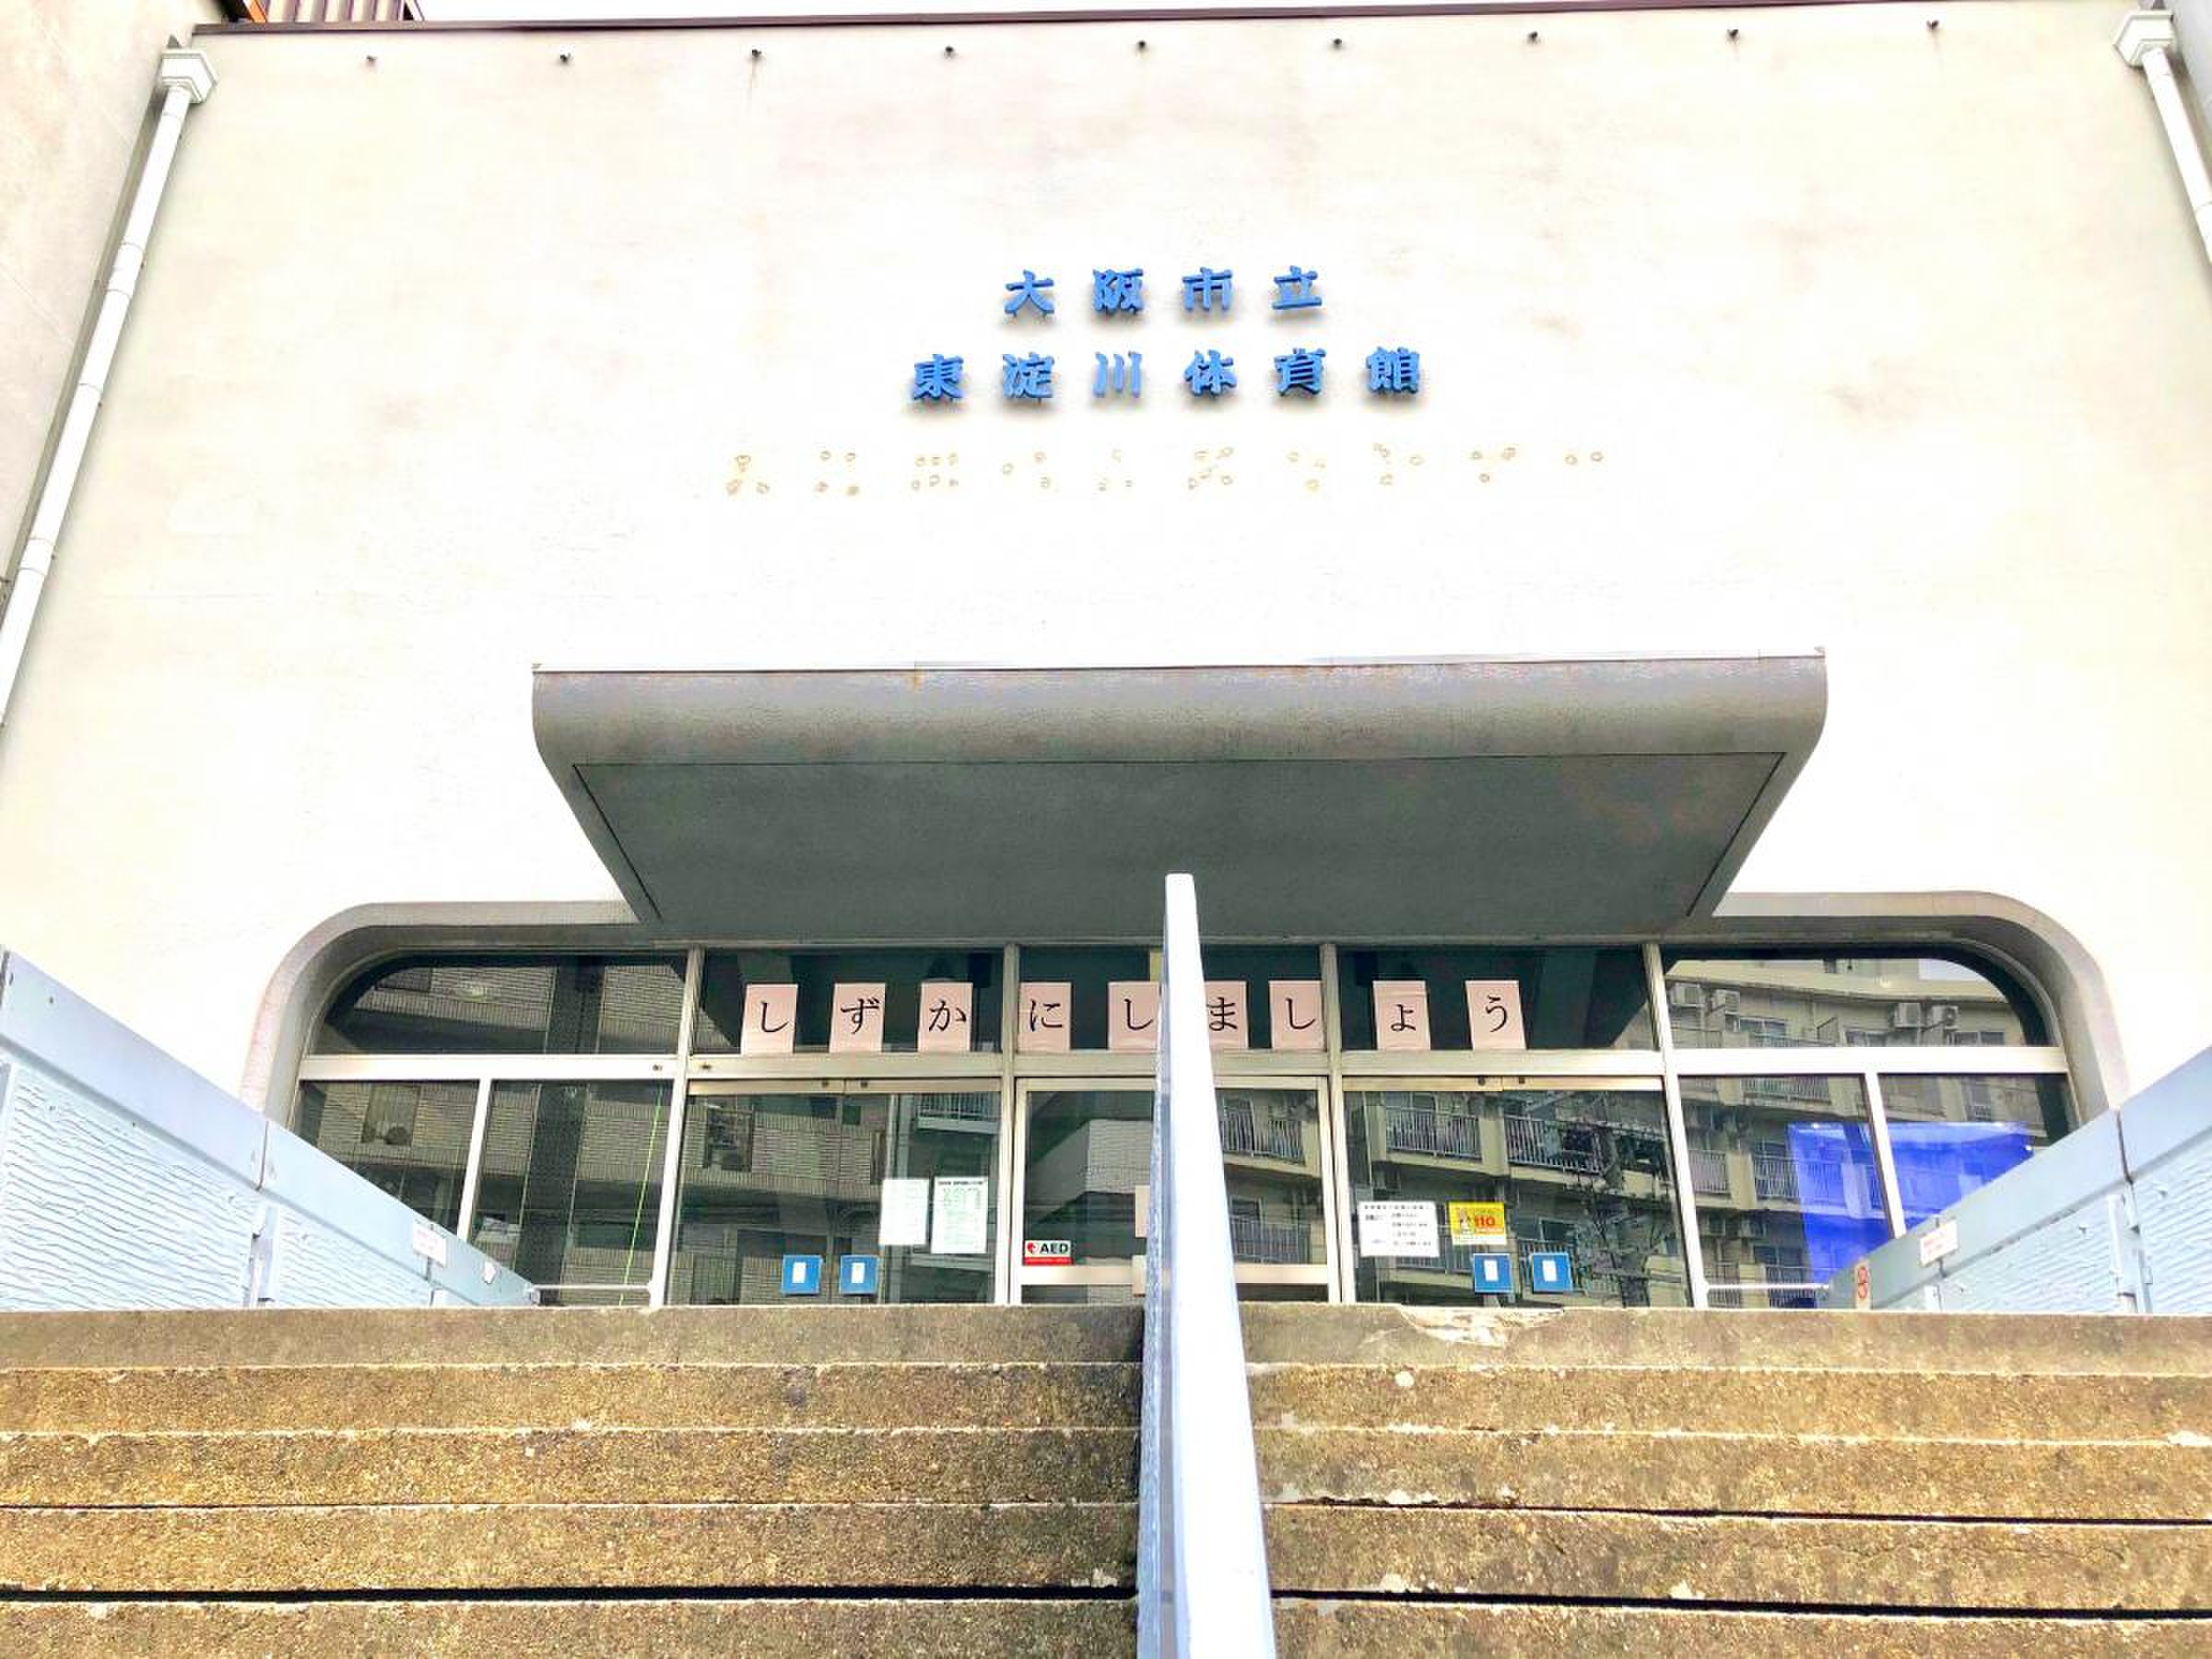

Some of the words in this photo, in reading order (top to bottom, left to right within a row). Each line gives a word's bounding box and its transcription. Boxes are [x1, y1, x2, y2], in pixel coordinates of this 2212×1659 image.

[1004, 265, 1323, 317] 大阪市立
[912, 347, 1421, 401] 東淀川体育館
[760, 996, 1508, 1034] しずかにしましょう
[1041, 1243, 1069, 1254] AED
